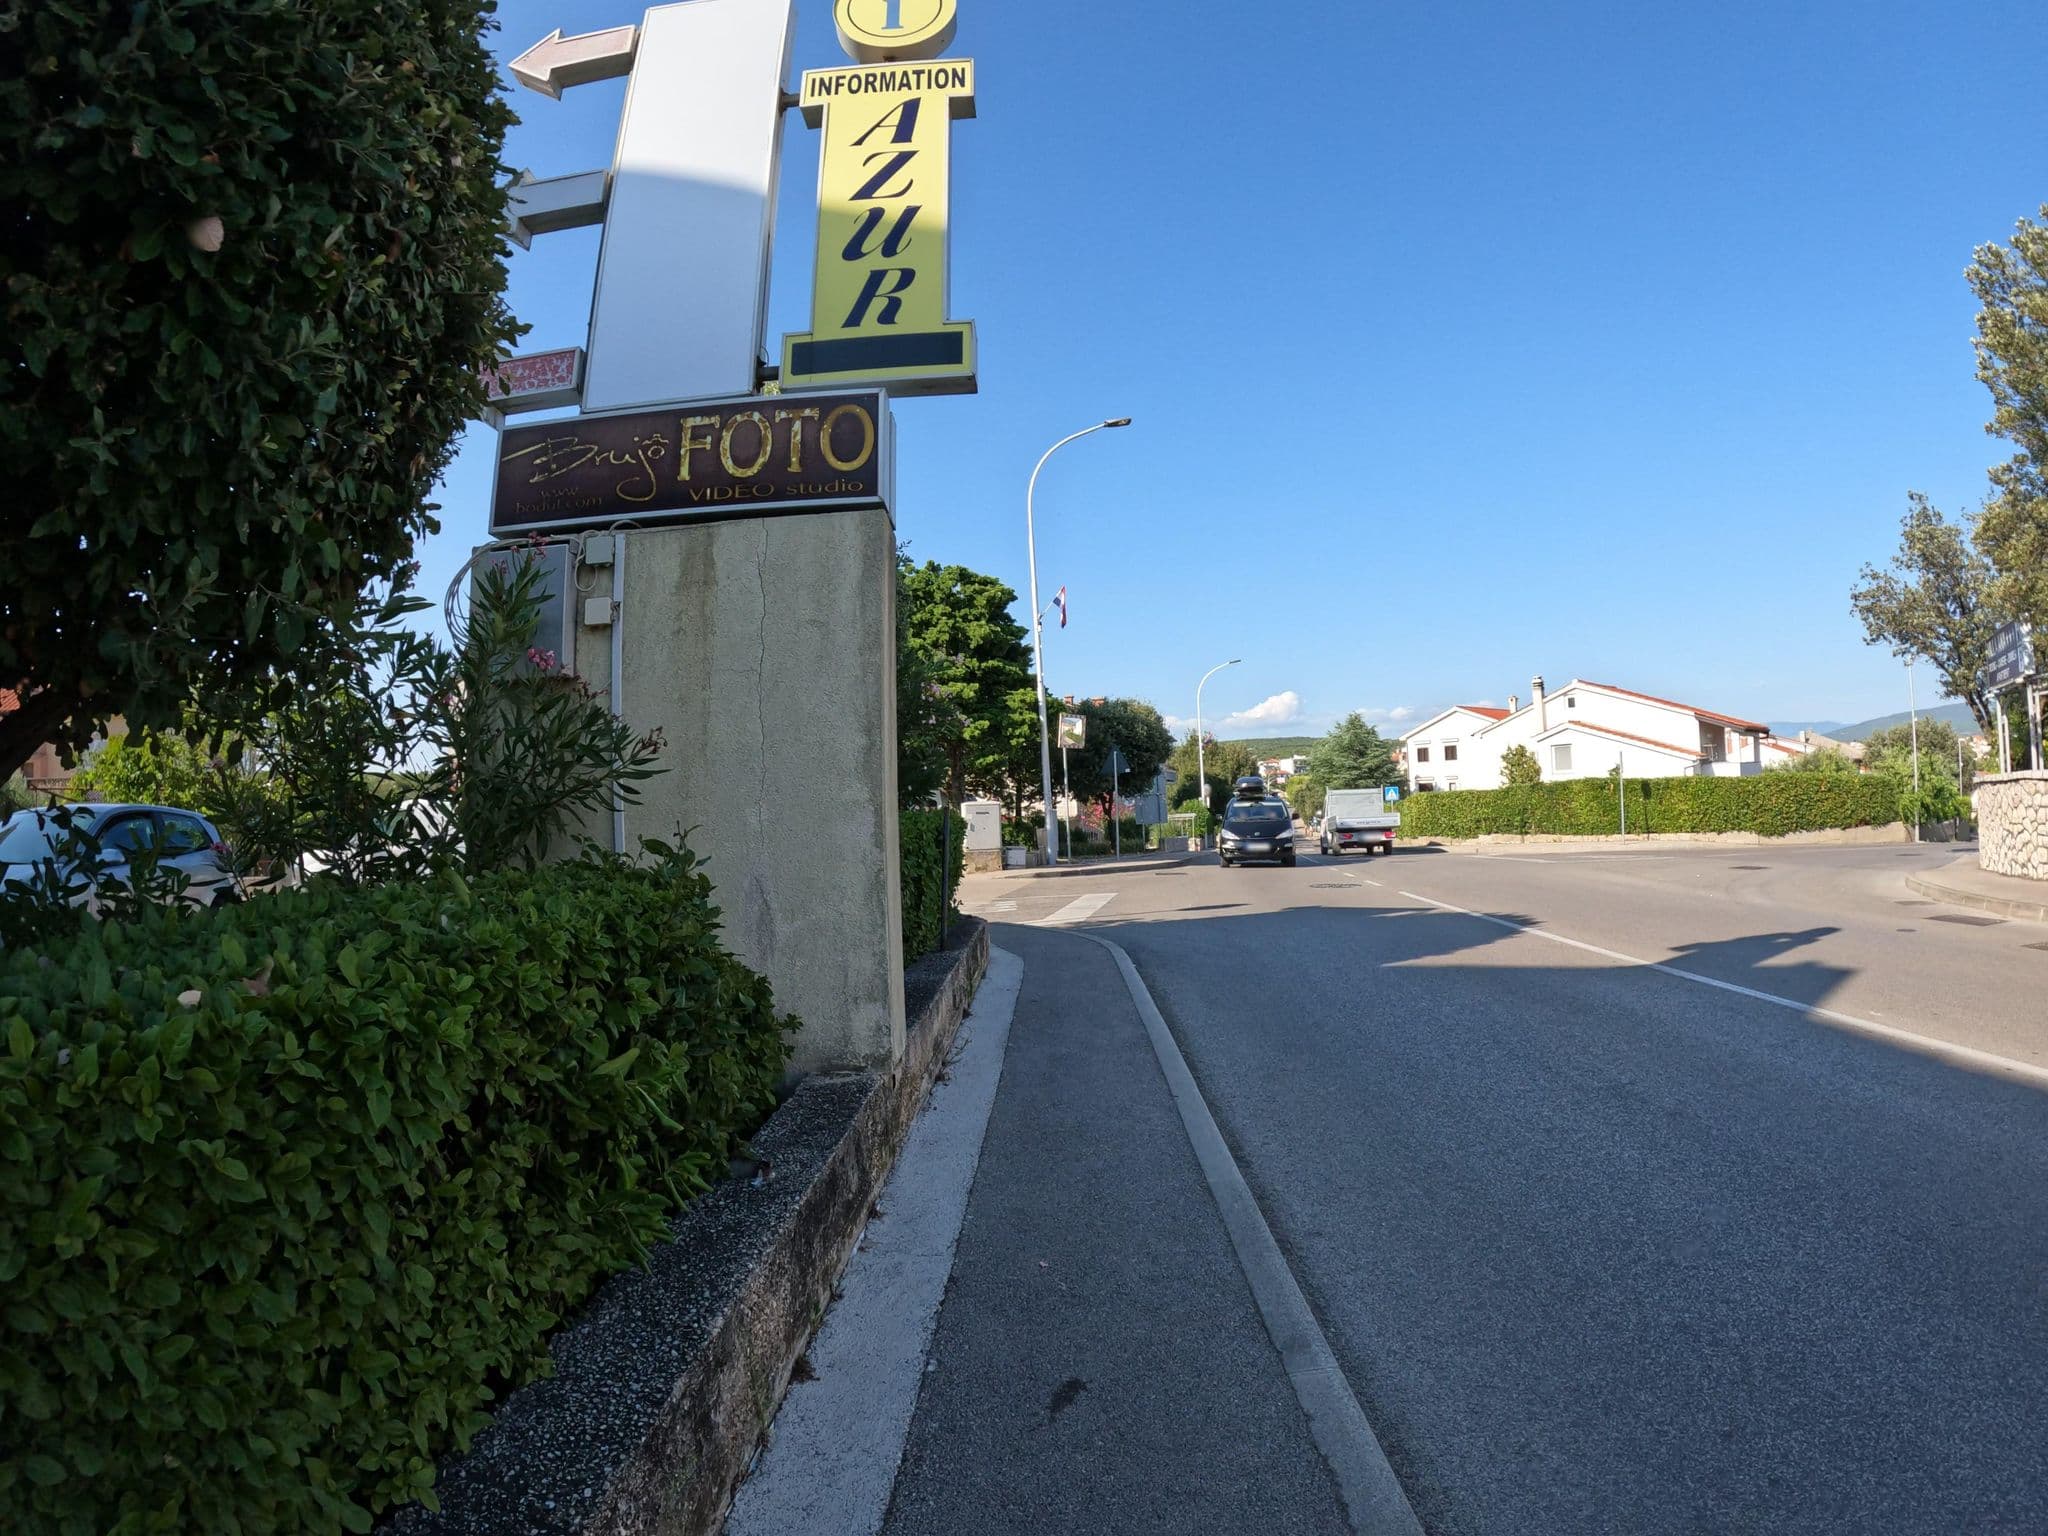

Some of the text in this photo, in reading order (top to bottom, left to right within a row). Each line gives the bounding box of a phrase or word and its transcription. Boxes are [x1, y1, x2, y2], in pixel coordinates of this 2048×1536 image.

[810, 67, 966, 97] INFORMATION
[841, 97, 922, 328] AZUR
[677, 404, 874, 481] FOTO
[689, 478, 864, 501] VIDEO studio
